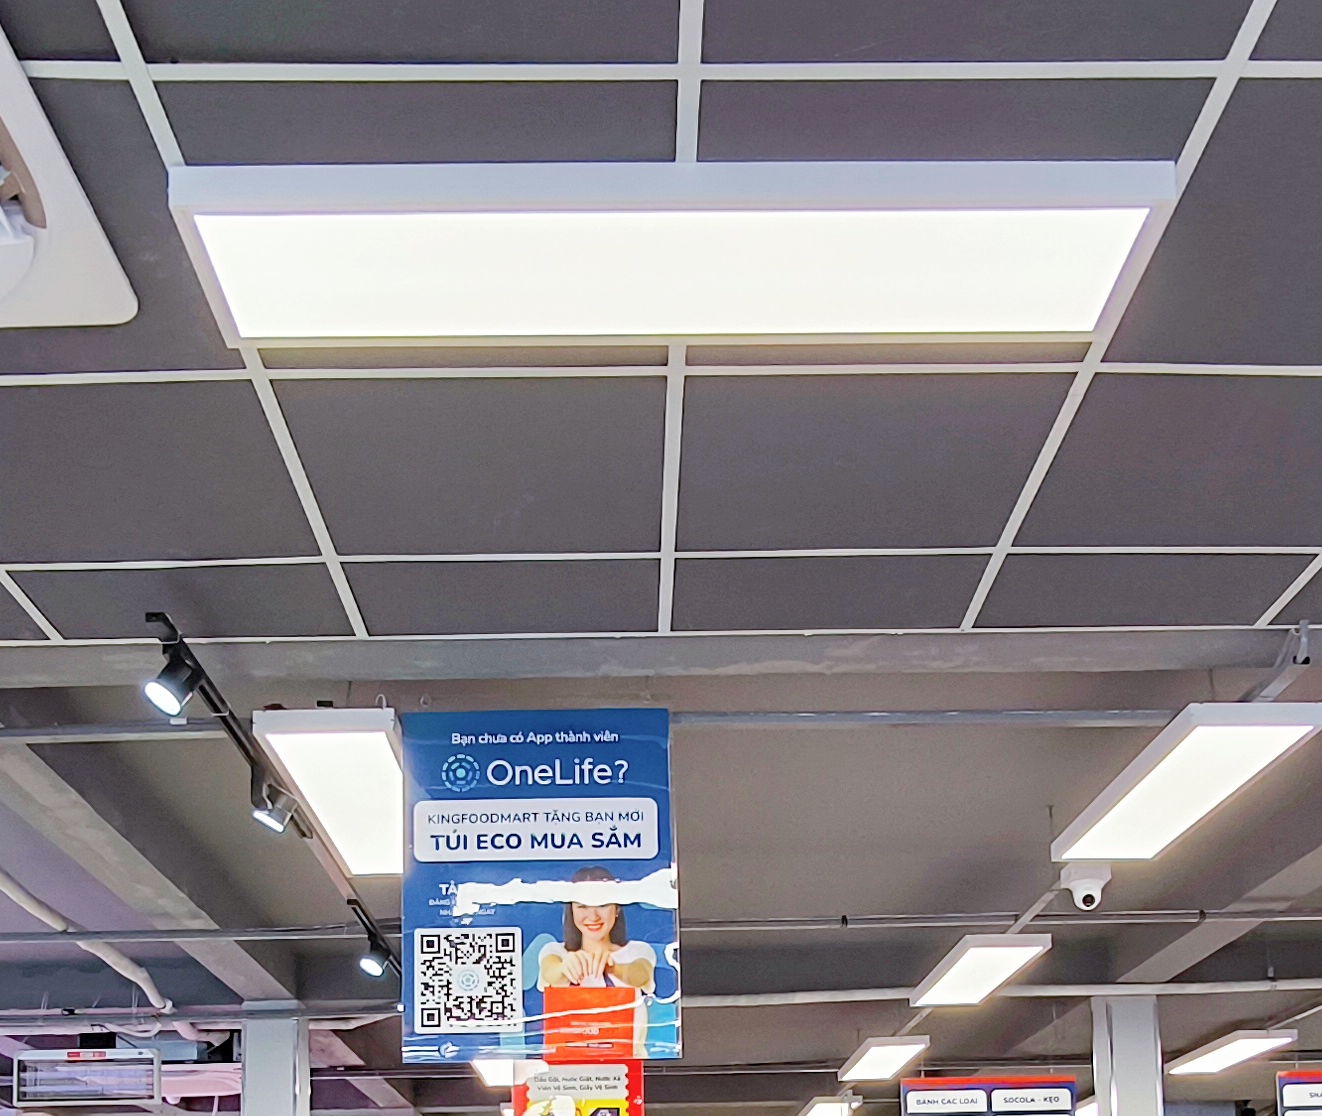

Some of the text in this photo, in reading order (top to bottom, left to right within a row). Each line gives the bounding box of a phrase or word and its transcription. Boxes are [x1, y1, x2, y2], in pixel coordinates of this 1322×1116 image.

[451, 730, 619, 745] Bạn chưa có App thành viên
[487, 758, 628, 785] OneLife?
[427, 809, 644, 825] KINGFOODMART TẶNG BẠN MỚI
[430, 825, 642, 850] TÚI ECO MUA SẮM
